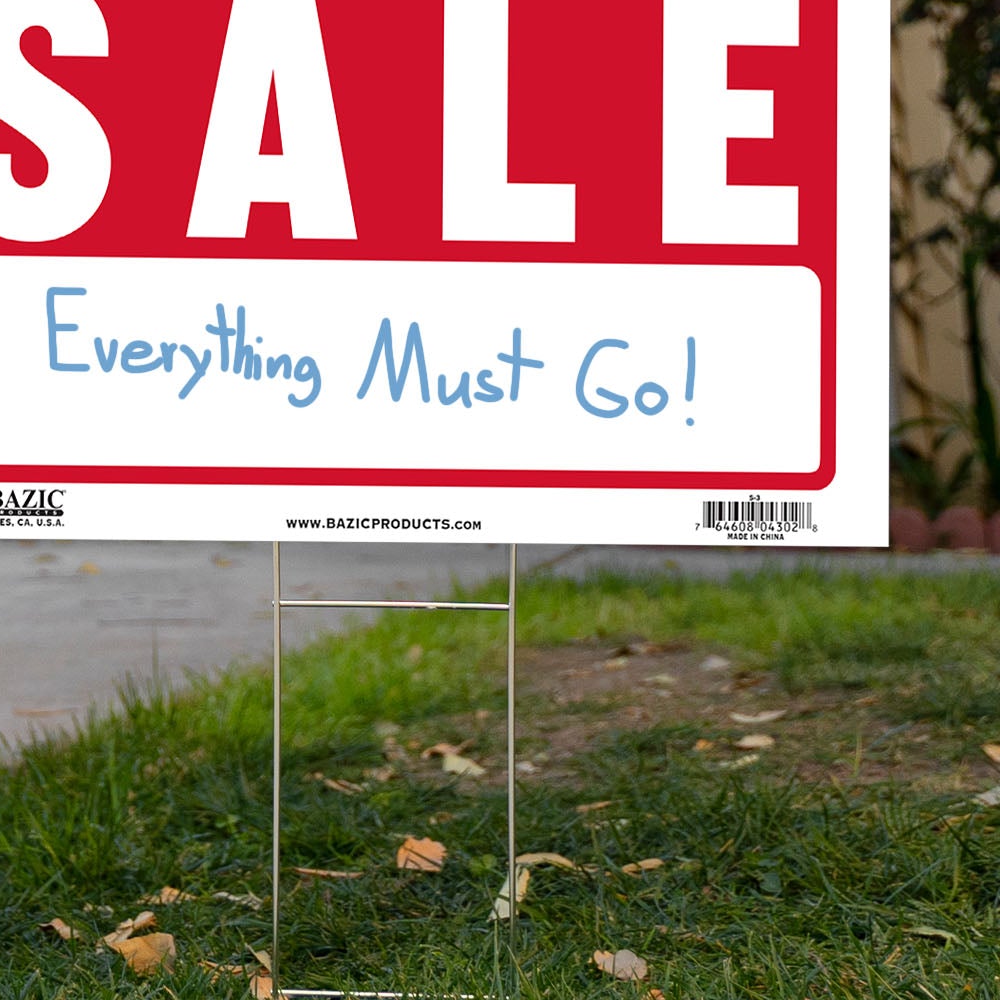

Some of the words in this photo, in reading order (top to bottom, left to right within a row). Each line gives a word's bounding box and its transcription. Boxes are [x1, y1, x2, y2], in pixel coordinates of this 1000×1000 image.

[46, 287, 322, 408] Everything
[356, 317, 544, 408] Must
[576, 336, 696, 426] Go!
[17, 518, 33, 527] CA,
[695, 522, 701, 531] 7
[715, 522, 754, 531] 64608
[760, 522, 798, 532] 04302
[812, 524, 818, 533] 8
